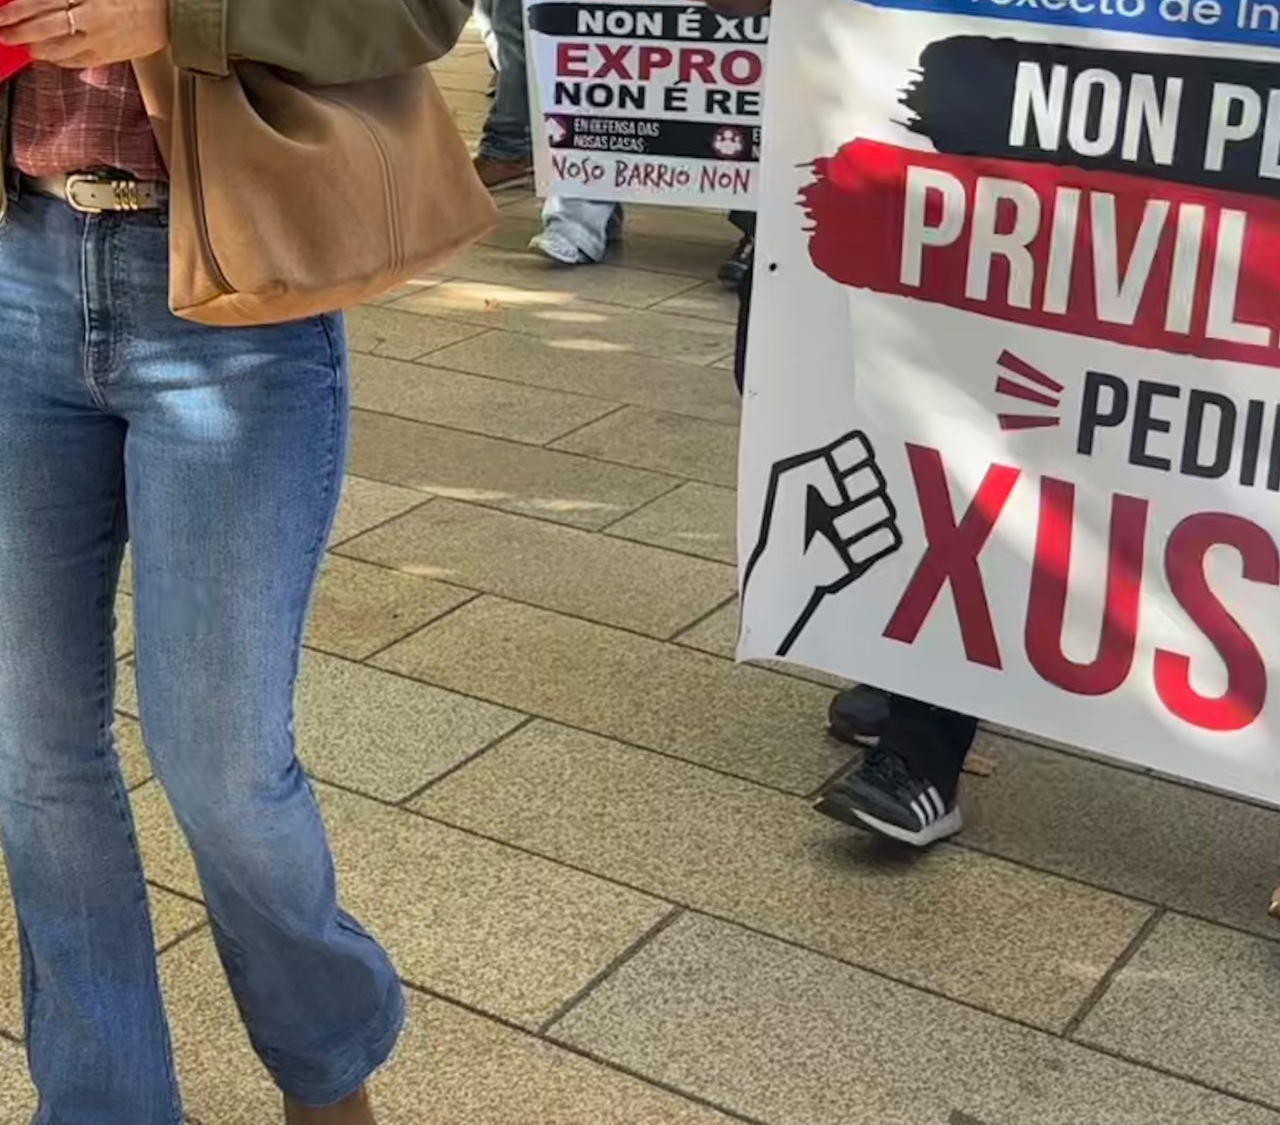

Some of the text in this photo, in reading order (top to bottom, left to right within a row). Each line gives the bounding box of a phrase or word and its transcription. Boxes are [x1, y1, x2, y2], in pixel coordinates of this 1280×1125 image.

[576, 7, 769, 41] NON É XU
[556, 42, 763, 87] EXPRO
[553, 79, 761, 116] NON É RE
[1007, 60, 1184, 167] NON
[573, 134, 609, 150] NOSAS
[589, 118, 636, 136] DEFENSA
[637, 121, 661, 138] DAS
[614, 159, 691, 188] BARRIO
[899, 164, 1272, 348] PRIVIL
[881, 442, 1280, 733] XUS
